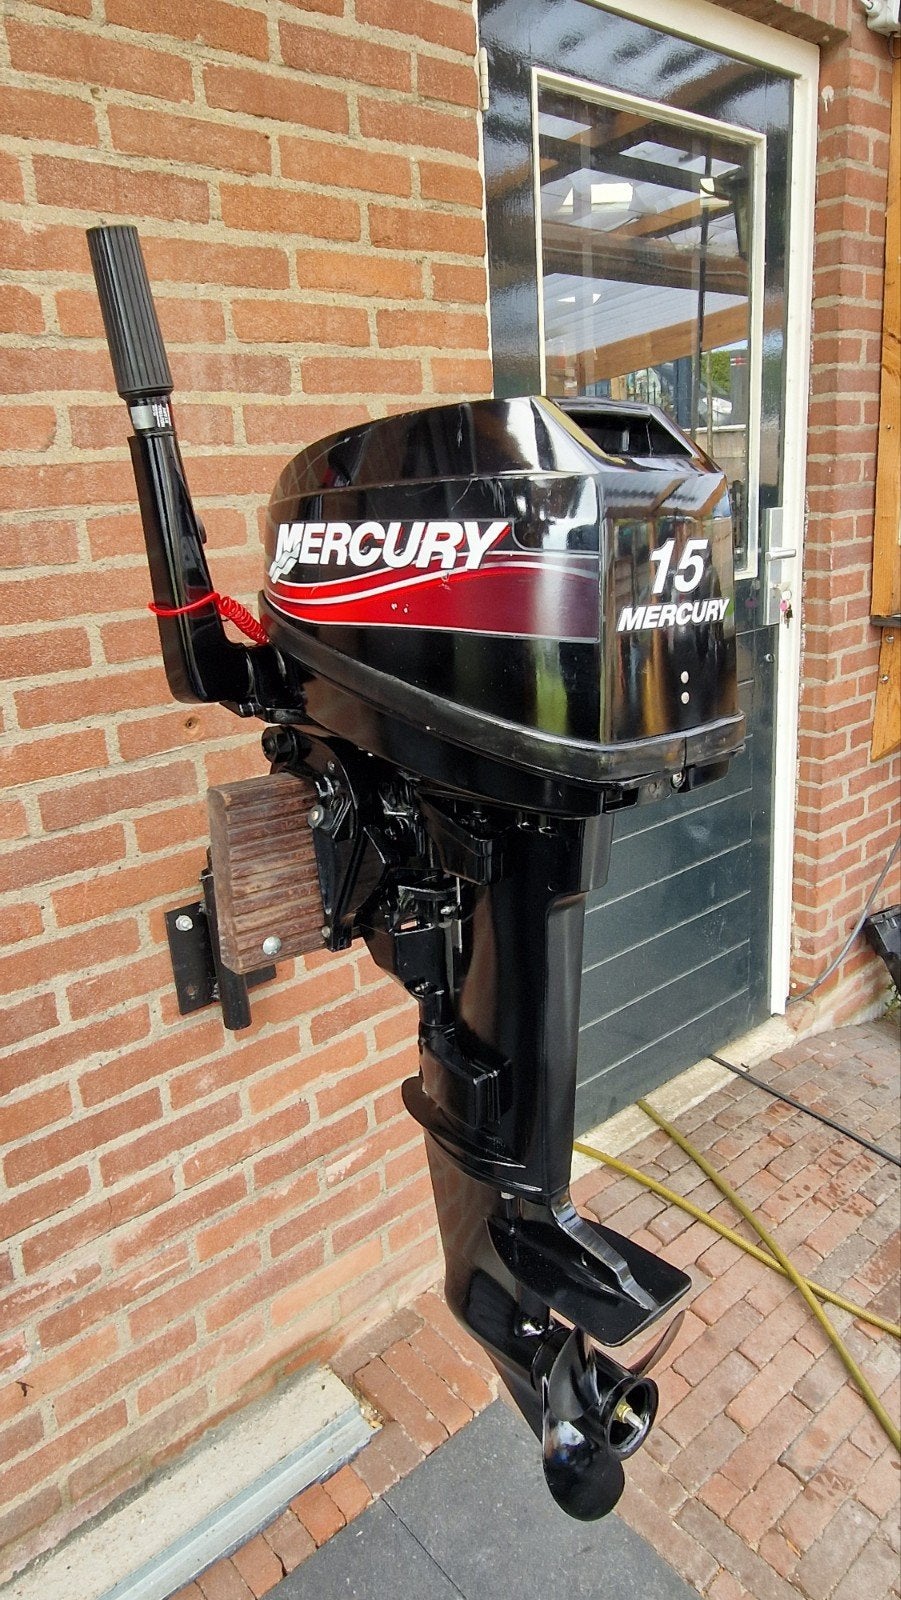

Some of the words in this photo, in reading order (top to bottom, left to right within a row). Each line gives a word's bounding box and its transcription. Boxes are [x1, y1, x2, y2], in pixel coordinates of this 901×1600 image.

[269, 521, 511, 583] MERCURY
[651, 538, 709, 594] 15
[617, 598, 730, 632] MERCURY
